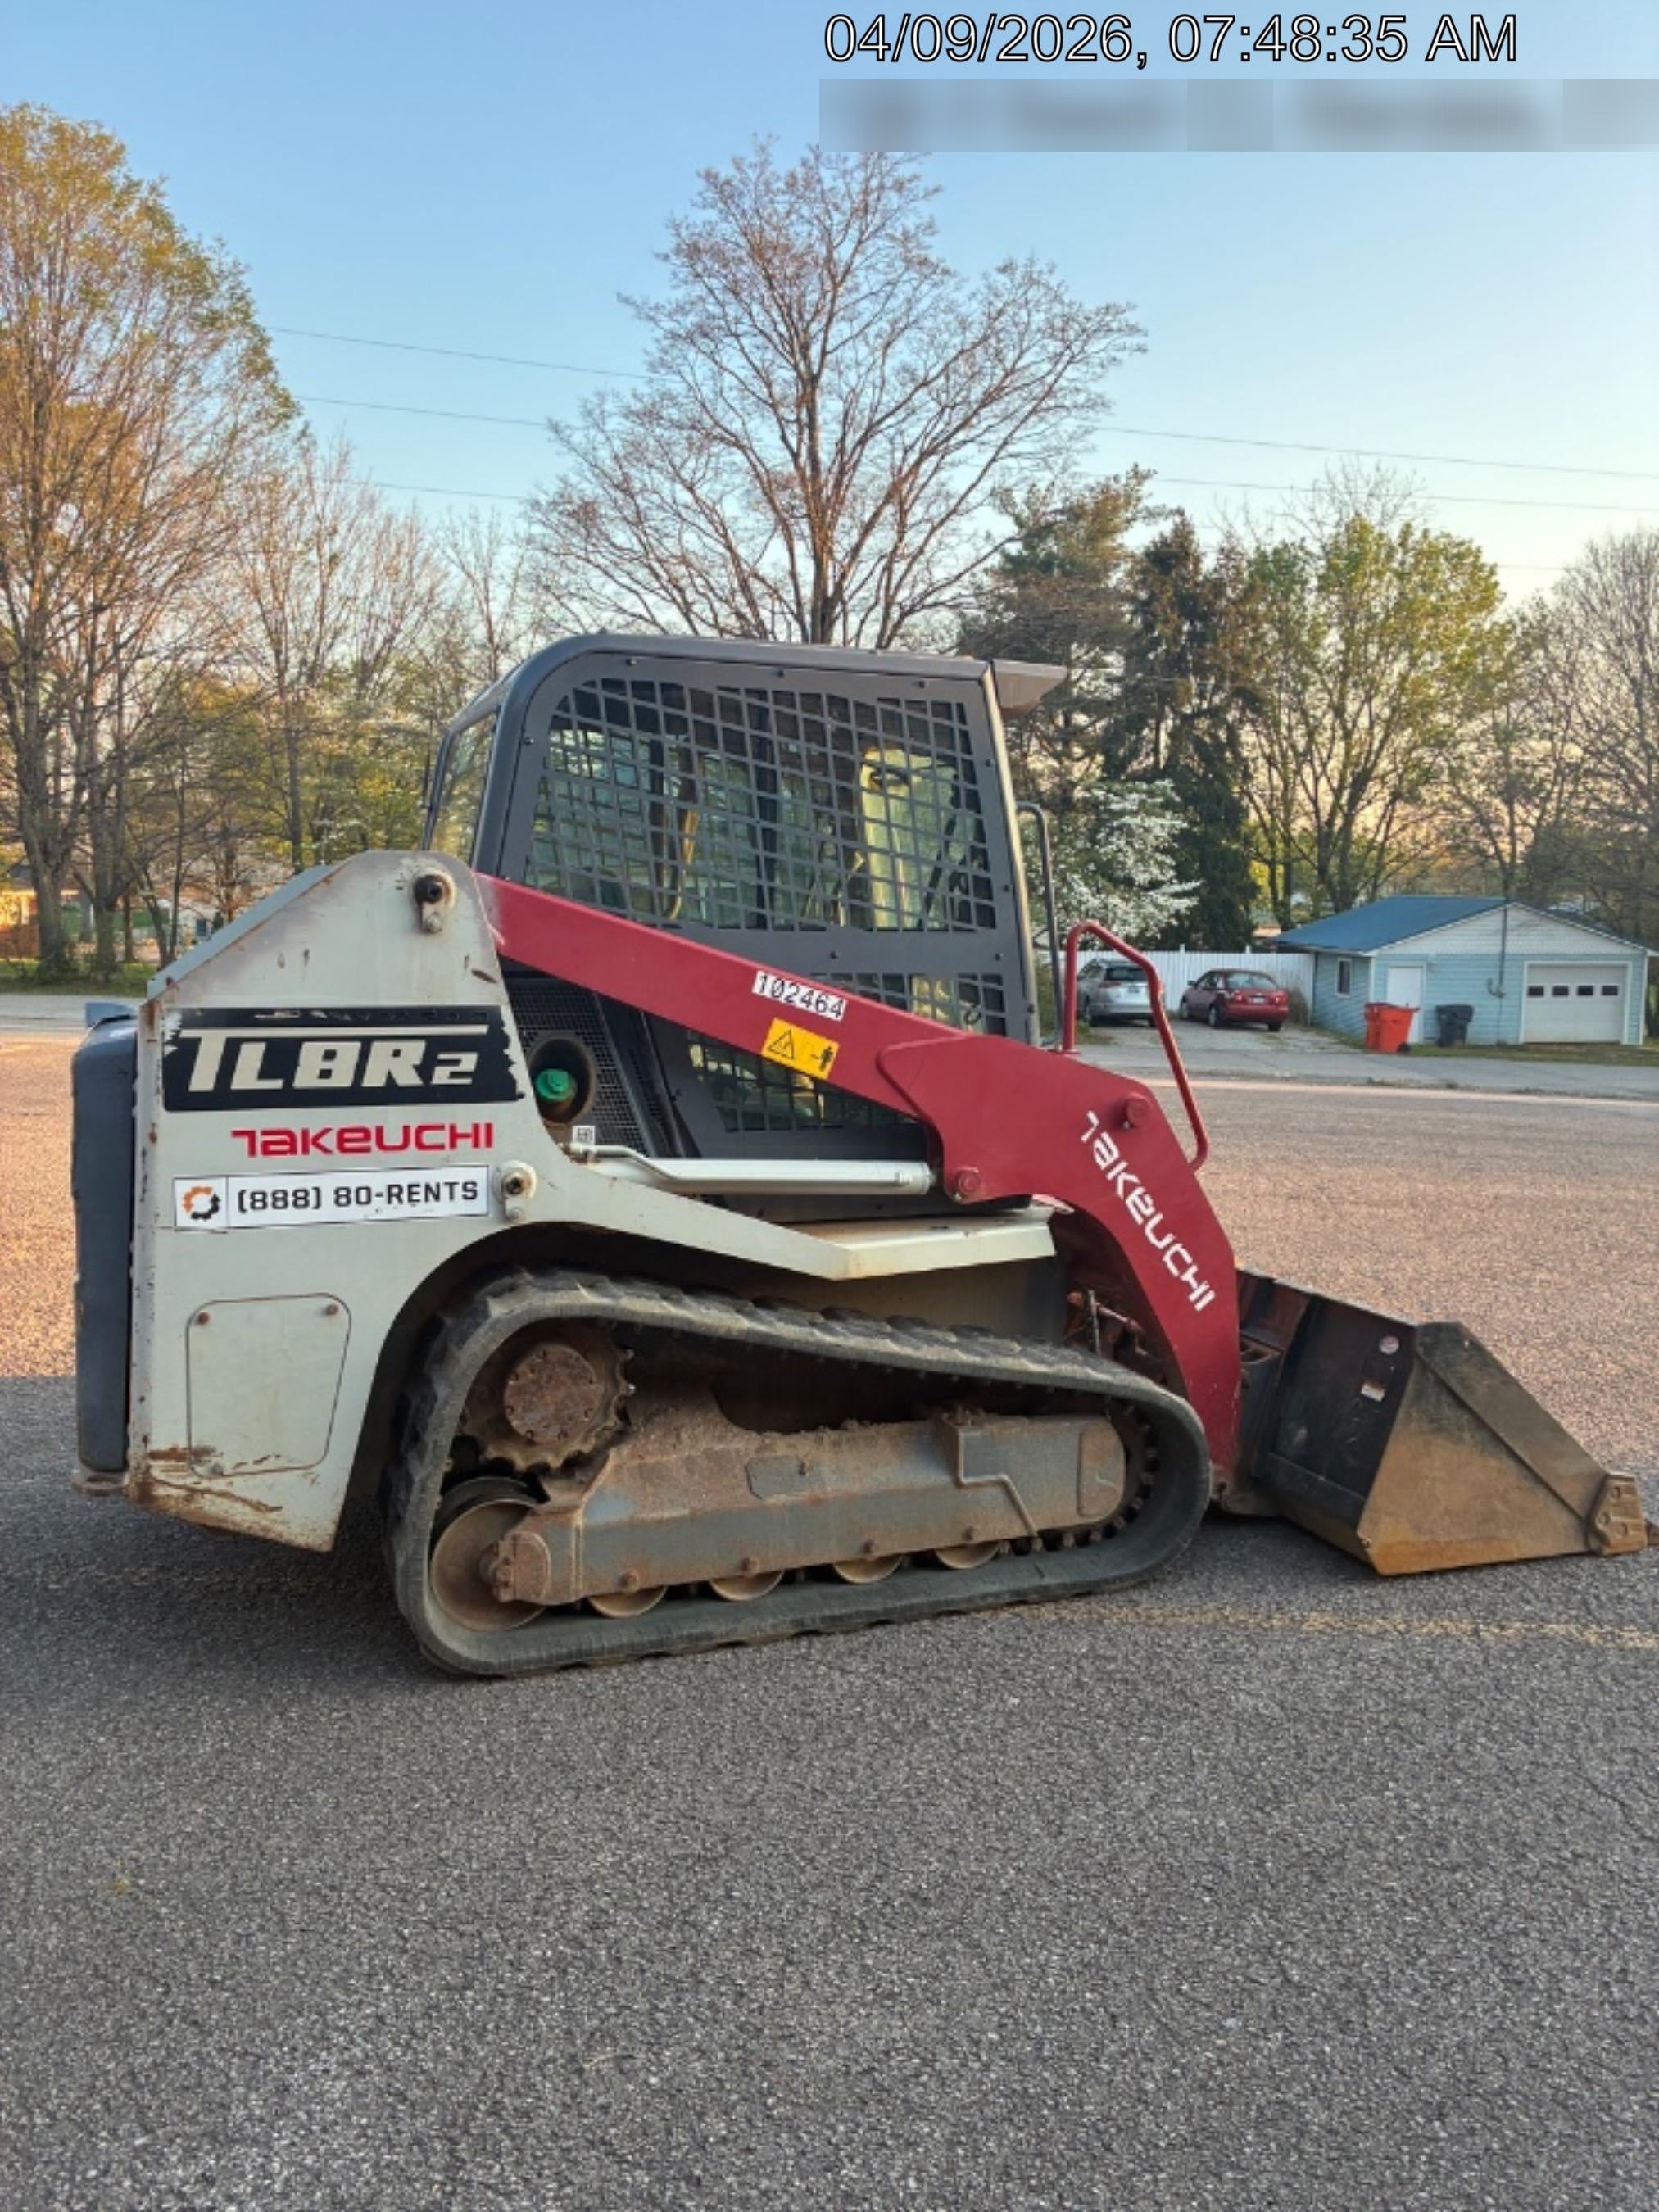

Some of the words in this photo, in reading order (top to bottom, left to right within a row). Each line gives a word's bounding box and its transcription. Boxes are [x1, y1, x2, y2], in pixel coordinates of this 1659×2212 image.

[757, 974, 845, 1018] 102464
[237, 1187, 322, 1214] (888)
[333, 1180, 478, 1208] 80-RENTS
